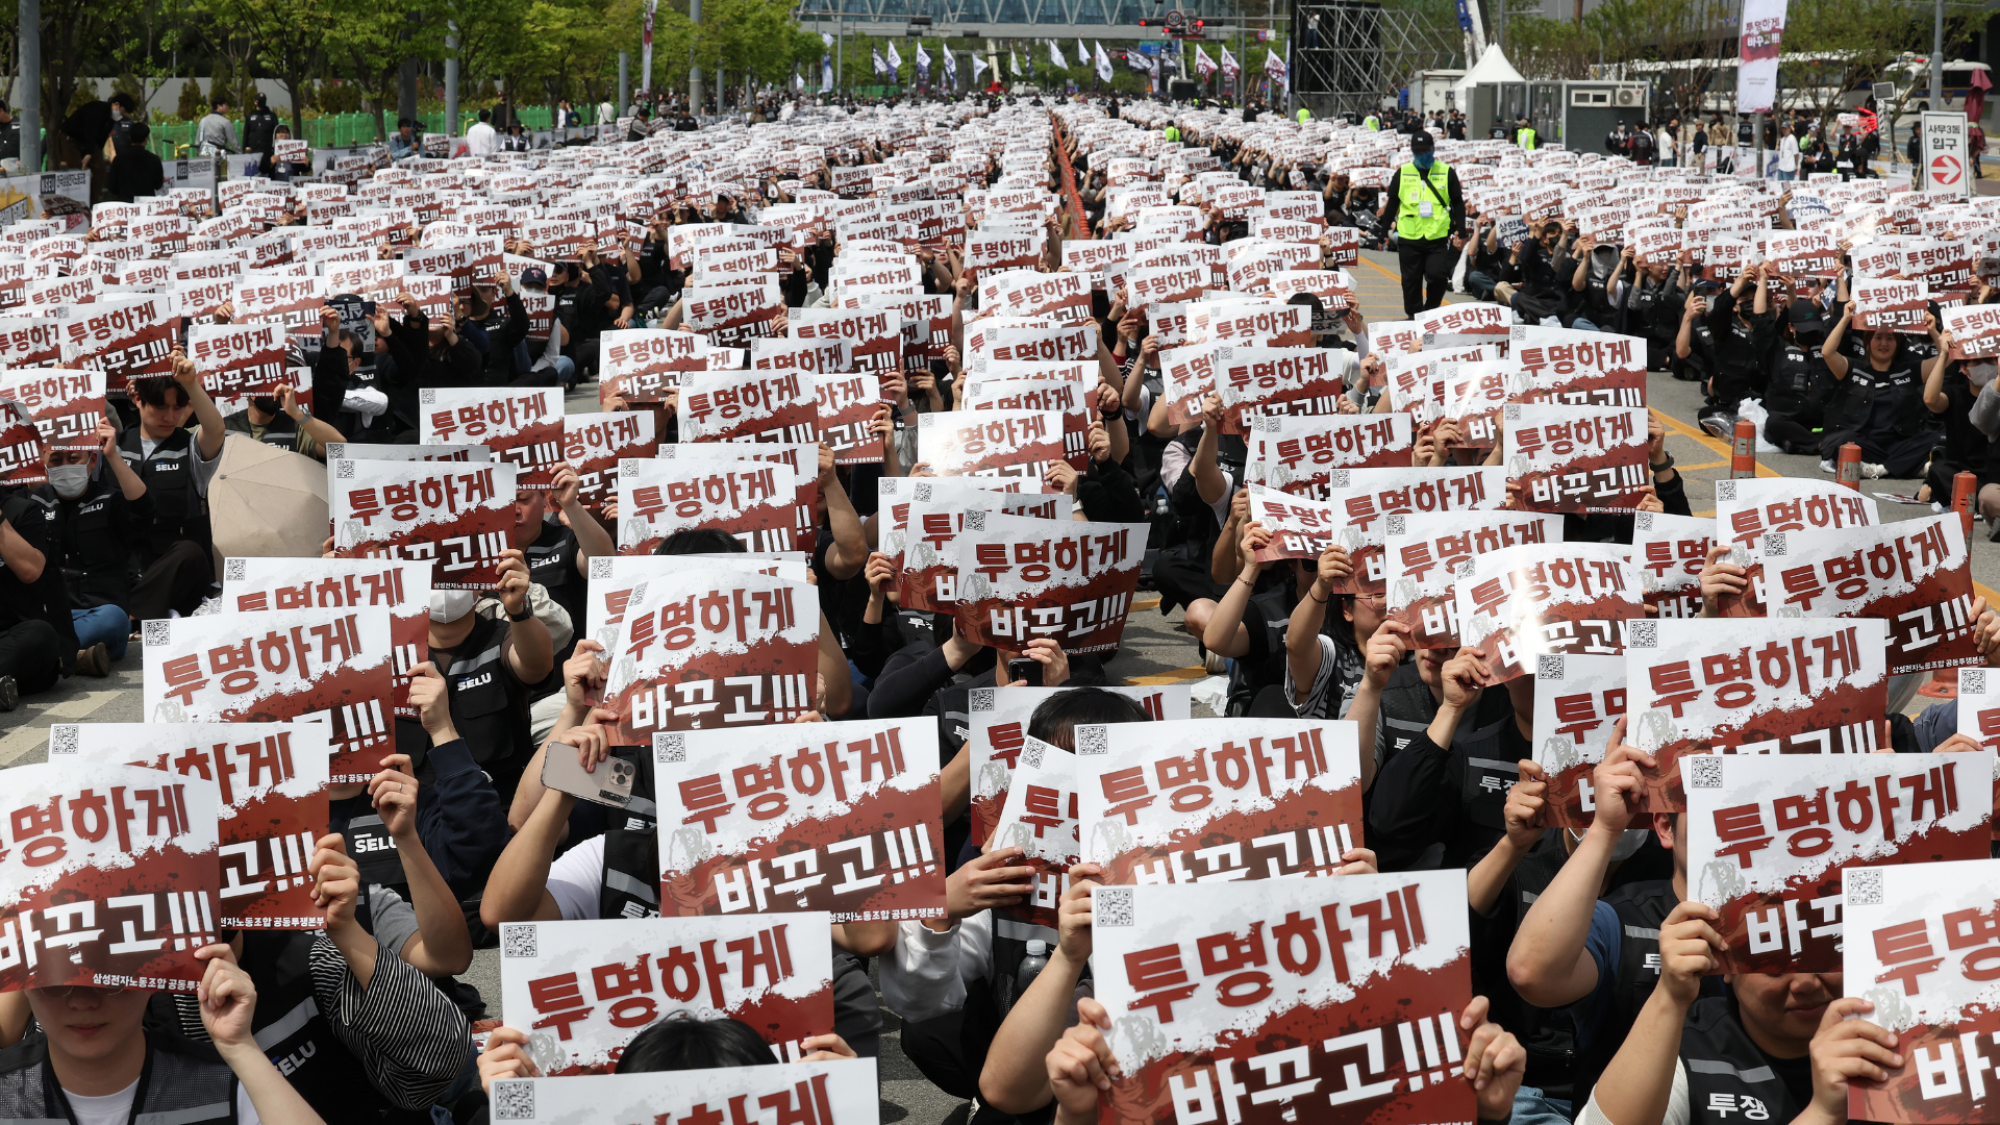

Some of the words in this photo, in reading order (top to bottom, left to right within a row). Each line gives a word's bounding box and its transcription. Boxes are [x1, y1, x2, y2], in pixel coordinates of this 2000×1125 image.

[1170, 15, 1180, 23] 50
[1928, 124, 1961, 134] 사무3동
[1932, 137, 1957, 150] 입구
[396, 191, 436, 207] 투명하게
[838, 182, 871, 198] 바꾸고!!!
[891, 188, 930, 203] 투명하게
[989, 190, 1035, 204] 투명하게
[1124, 193, 1165, 208] 명하게
[1221, 189, 1259, 204] 투명하게
[1525, 190, 1561, 206] 투명하게
[311, 202, 352, 219] 투명하게
[464, 208, 507, 221] 투명하게
[886, 207, 934, 223] 투명하게
[1270, 204, 1316, 221] 투명하게
[1590, 207, 1629, 226] 투명하게
[132, 220, 182, 238] 투명하게
[302, 232, 350, 250] 투명하게
[529, 221, 578, 241] 투명하게
[1260, 225, 1312, 243] 투명하게
[1597, 228, 1626, 241] 바꾸고
[30, 240, 78, 258] 투명하게
[258, 240, 288, 260] 명하게
[537, 240, 581, 257] 바꾸고!!!
[972, 239, 1031, 258] 투명하게
[1068, 243, 1126, 266] 투명하게
[1648, 248, 1678, 263] 바꾸고
[1772, 236, 1828, 254] 투명하게
[1907, 245, 1965, 265] 투명하게
[331, 265, 394, 285] 투명하게
[408, 250, 467, 274] 투명하게
[1779, 256, 1836, 274] 바꾸고!!!
[32, 279, 94, 304] 투명하게
[241, 278, 315, 306] 투명하게
[1007, 275, 1080, 301] 투명하게
[1135, 269, 1201, 296] 투명하게
[1276, 274, 1340, 293] 투명하게
[1858, 283, 1919, 305] 투명하게
[690, 288, 766, 321] 투명하게
[67, 301, 157, 345] 투명하게
[1216, 309, 1300, 340] 투명하게
[1422, 306, 1502, 337] 투명하게
[1866, 309, 1924, 328] 바꾸고!!!
[195, 327, 273, 359] 투명하게
[608, 335, 695, 366] 투명하게
[1228, 352, 1329, 391] 투명하게
[1520, 340, 1632, 378] 투명하게
[204, 362, 284, 391] 바꾸고!!!
[688, 373, 801, 424] 투명하게
[33, 411, 99, 443] 꾸고!!!
[431, 392, 547, 441] 투명하게
[566, 416, 640, 458] 명하게
[958, 414, 1048, 455] 명하게
[1277, 418, 1394, 470] 투명하게
[1515, 413, 1633, 465] 투명하게
[155, 463, 180, 473] SELU
[348, 467, 496, 525] 투명하게
[631, 467, 777, 523] 투명하게
[1530, 464, 1646, 503] 바꾸고!!!
[1345, 472, 1485, 527] 투명하게
[1731, 495, 1869, 549] 투명하게
[530, 554, 560, 568] SELU
[976, 529, 1128, 584] 투명하게
[1401, 519, 1545, 582] 투명하게
[1780, 521, 1950, 611] 투명하게
[627, 588, 795, 661] 투명하게
[990, 592, 1126, 641] 바꾸고!!!
[1884, 594, 1975, 651] 고!!!
[163, 614, 362, 706] 투명하게
[1649, 627, 1859, 718] 투명하게
[1892, 659, 1944, 674] 삼성전자노동조합
[457, 673, 492, 691] SELU
[632, 673, 809, 731] 바꾸고!!!
[678, 727, 906, 834] 투명하게
[1099, 728, 1328, 826] 투명하게
[0, 784, 190, 867] 명하게
[1712, 762, 1957, 869] 투명하게
[354, 838, 397, 854] SELU
[220, 832, 314, 898] 고!!!
[714, 824, 935, 913] 바꾸고!!!
[221, 917, 272, 927] 전자노동조합
[273, 916, 324, 927] 공동투쟁본부
[830, 911, 889, 922] 성전자노동조합
[892, 907, 944, 919] 공동투쟁본부
[1122, 884, 1428, 1025] 투명하게
[1872, 898, 2000, 996] 투명
[93, 973, 167, 989] 삼성전자노동조합
[168, 979, 200, 991] 공동투
[528, 924, 794, 1041] 투명하게
[1168, 1012, 1463, 1125] 바꾸고!!!
[1706, 1092, 1770, 1121] 투쟁
